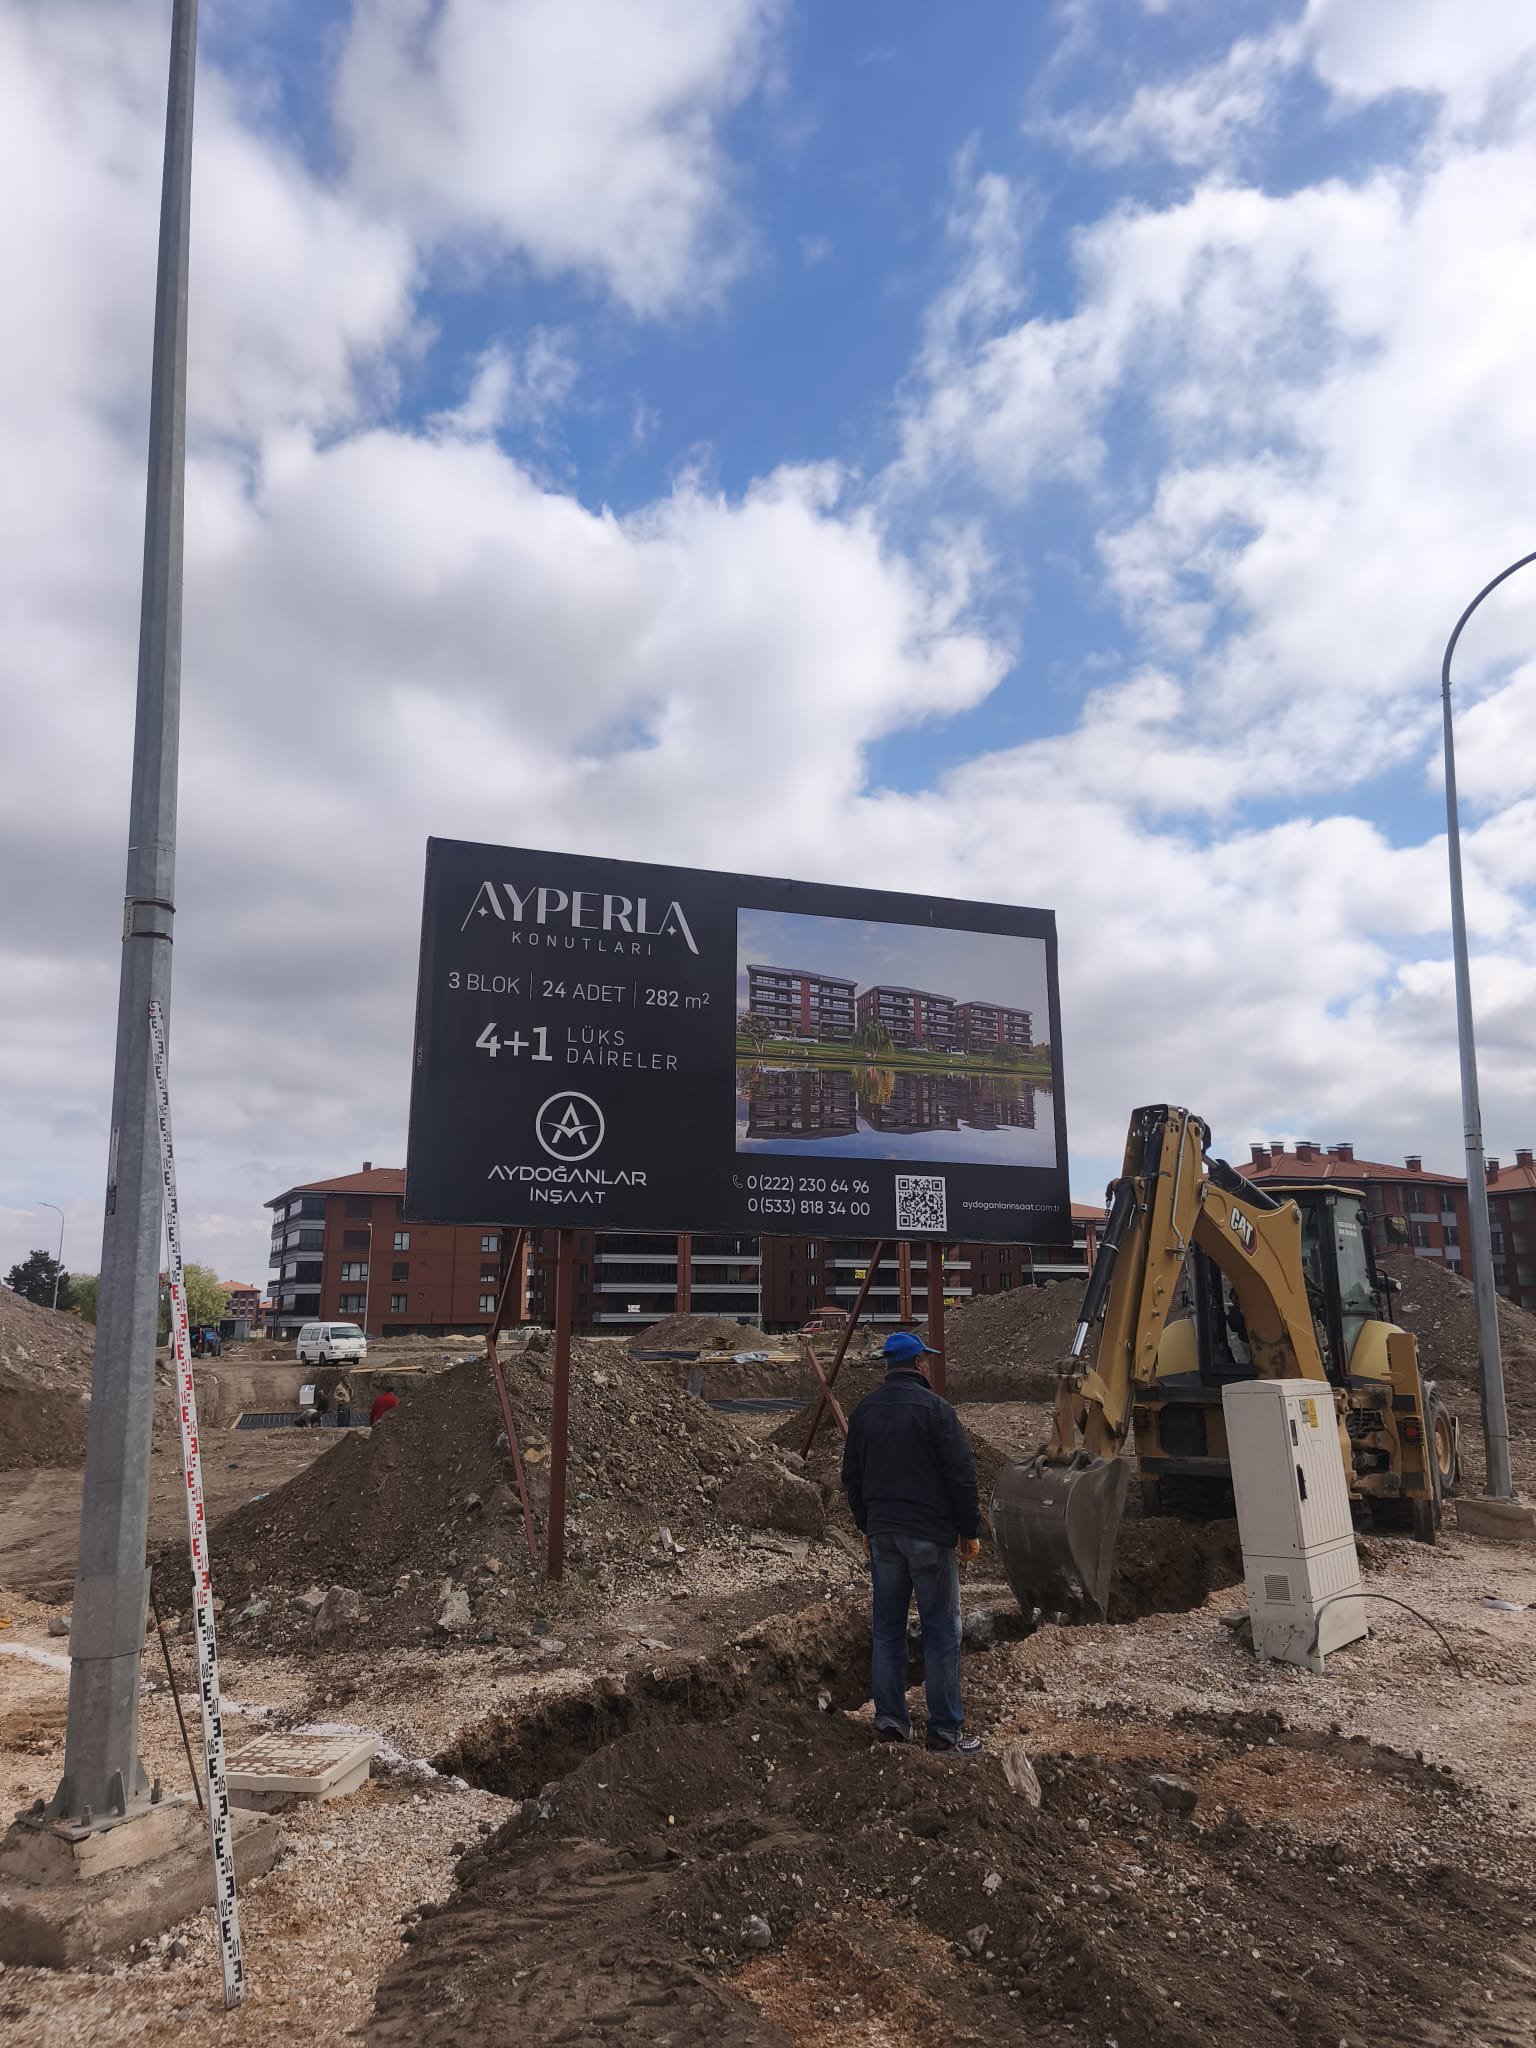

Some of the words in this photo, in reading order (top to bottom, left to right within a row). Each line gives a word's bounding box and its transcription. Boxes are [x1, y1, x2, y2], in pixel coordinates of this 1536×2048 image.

[461, 881, 700, 955] AYPERLA
[511, 931, 652, 955] KONUTLARI
[448, 971, 460, 989] 3
[467, 973, 520, 995] BLOK
[542, 980, 567, 999] 24
[572, 983, 626, 1003] ADET
[645, 988, 679, 1008] 282
[475, 1022, 553, 1062] 4+1
[567, 1024, 625, 1046] LÜKS
[488, 1165, 647, 1186] AYDOĞANLAR
[798, 1177, 827, 1193] 230
[830, 1179, 849, 1193] 64
[852, 1179, 870, 1194] 96
[800, 1199, 824, 1215] 818
[827, 1200, 847, 1215] 34
[850, 1201, 871, 1216] 00
[1230, 1207, 1253, 1246] CAT
[206, 1625, 214, 1640] 09
[218, 1775, 226, 1793] 05
[213, 1817, 222, 1835] 04
[224, 1855, 233, 1874] 03
[220, 1899, 228, 1917] 02
[231, 1939, 240, 1958] 01
